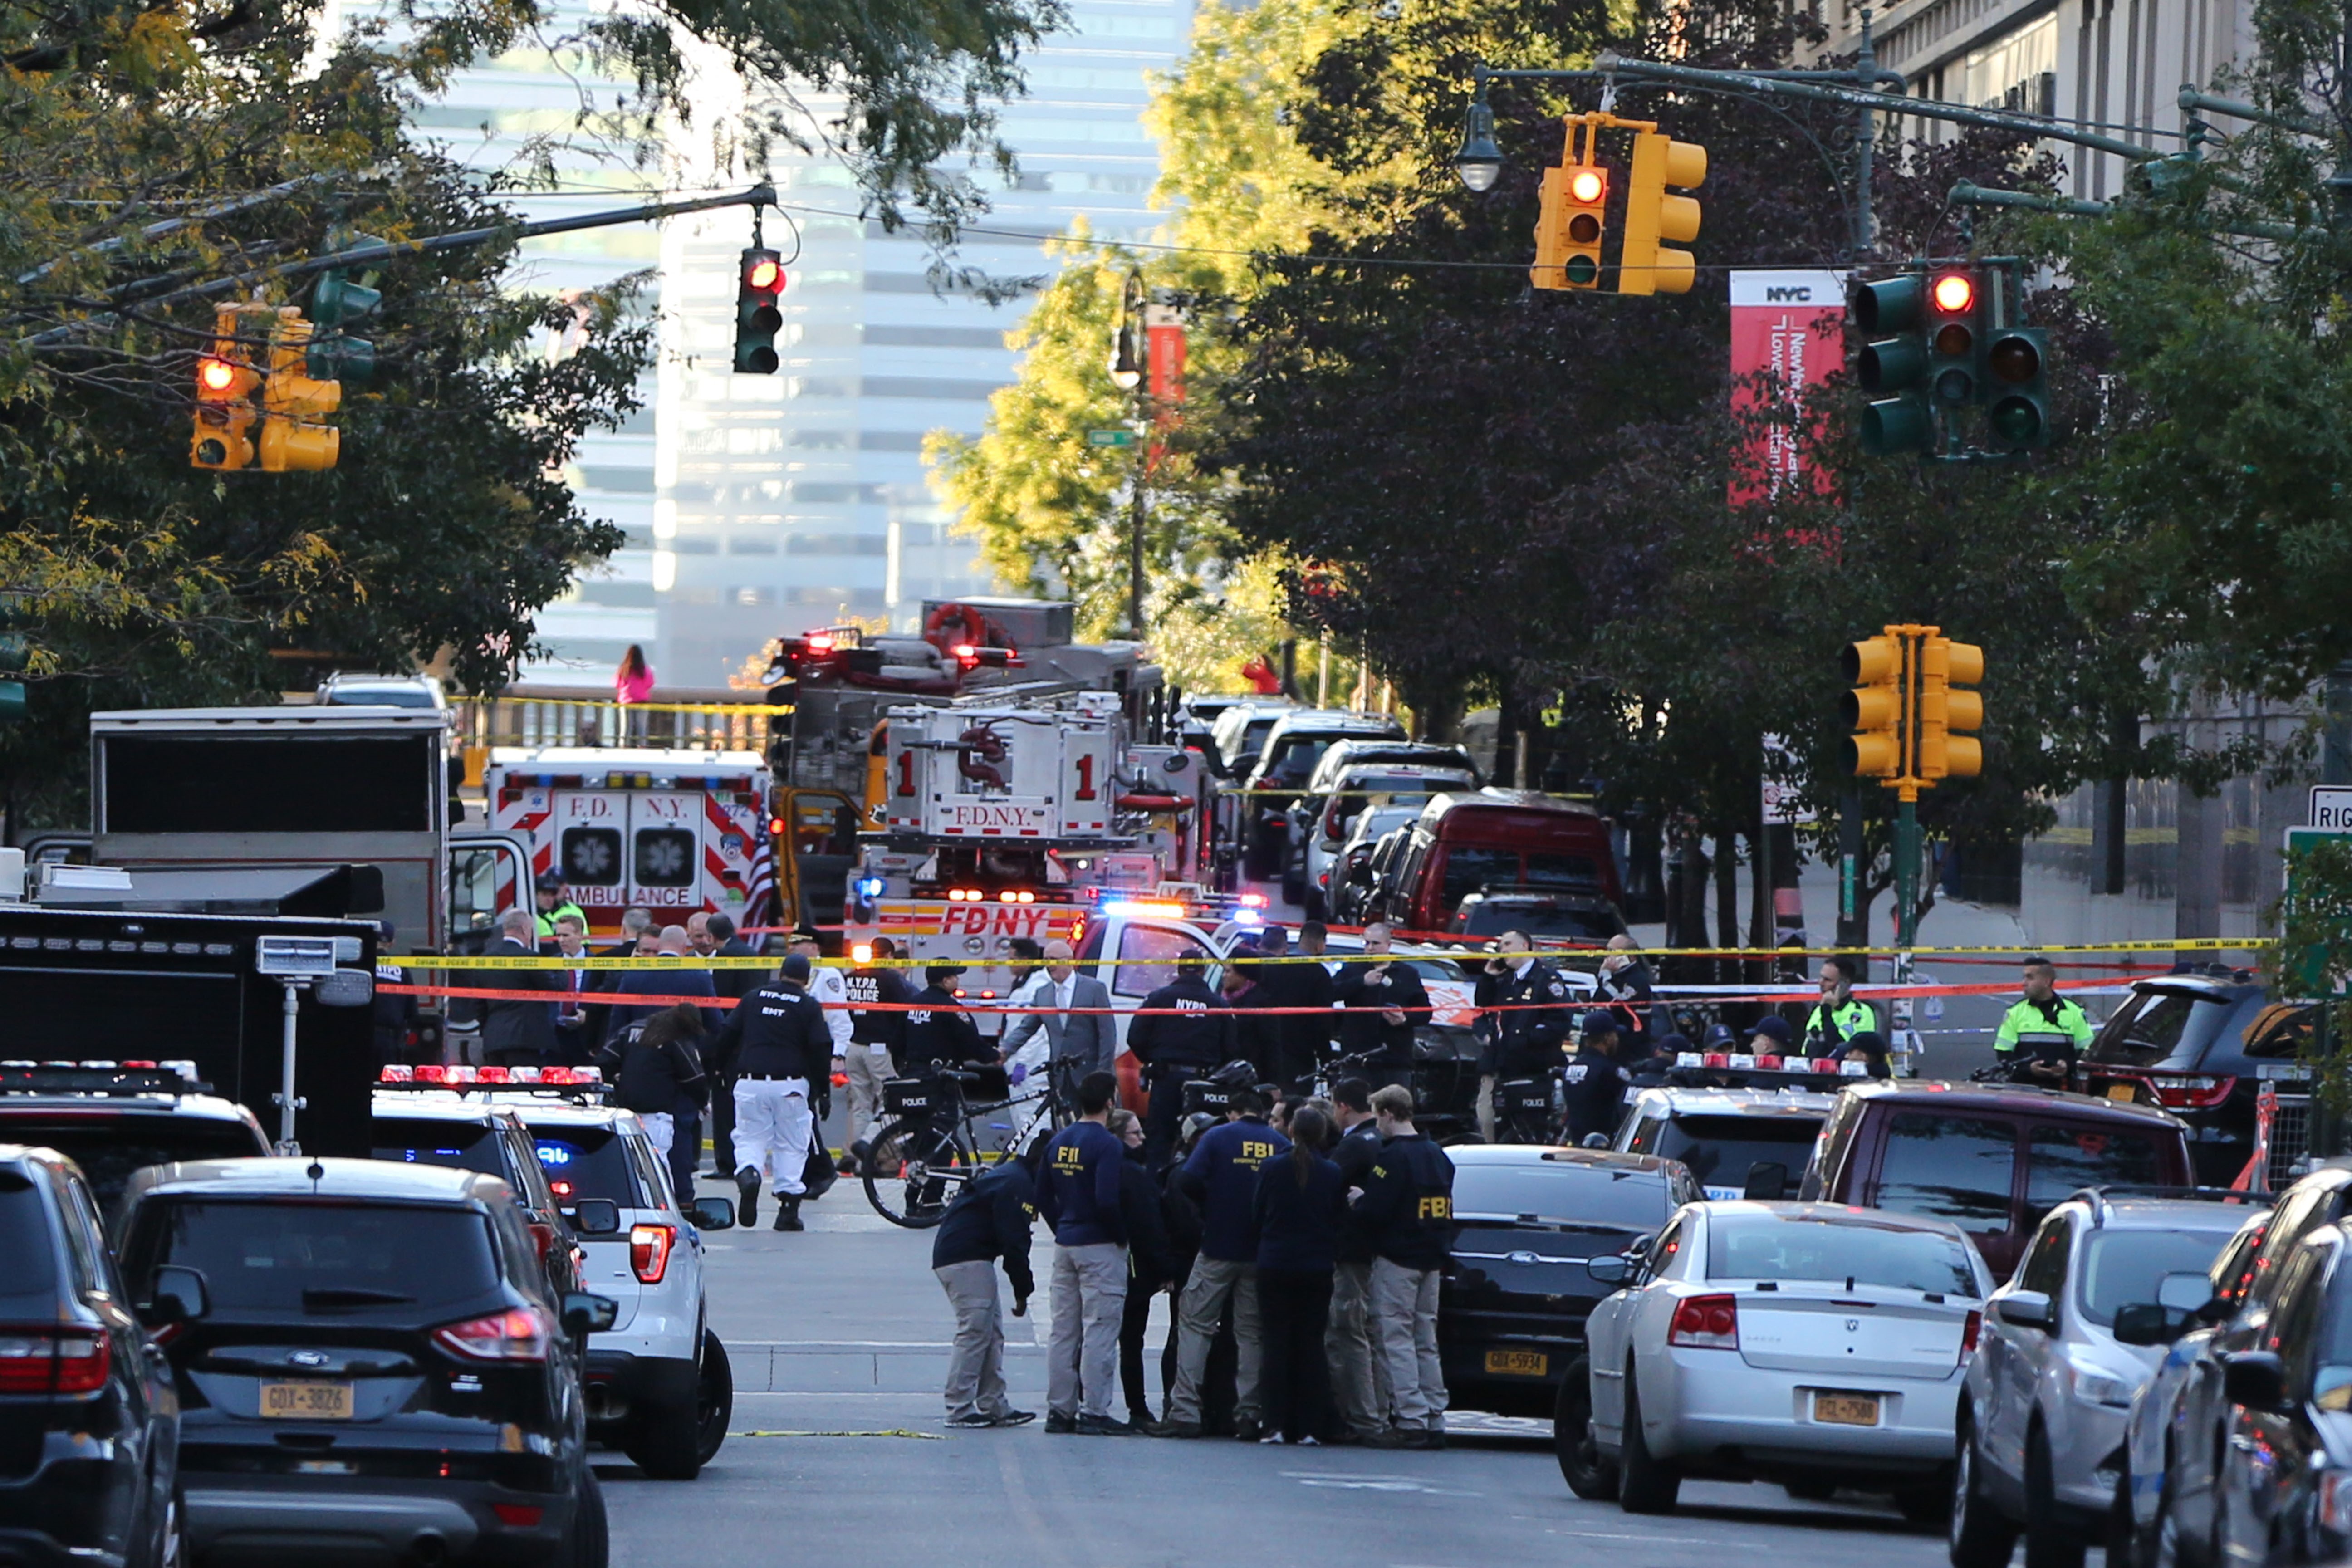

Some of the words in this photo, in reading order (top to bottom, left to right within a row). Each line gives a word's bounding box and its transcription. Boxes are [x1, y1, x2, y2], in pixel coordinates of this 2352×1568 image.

[1767, 287, 1811, 301] NYC
[897, 751, 915, 796] 1
[1076, 755, 1096, 800] 1
[570, 797, 612, 817] F.D.
[646, 799, 687, 818] N.Y.
[956, 806, 1031, 826] F.D.N.Y.
[2320, 807, 2352, 828] RIG
[564, 887, 690, 905] AMBULANCE
[942, 906, 1048, 936] FDNY
[846, 988, 880, 1002] POLICE
[1176, 998, 1208, 1010] NYPD
[762, 1006, 785, 1017] EMT
[902, 1097, 927, 1106] POLICE
[1204, 1093, 1229, 1103] POLICE
[1523, 1098, 1545, 1107] POLICE
[1007, 1114, 1037, 1152] NYPD
[1242, 1141, 1274, 1158] FBI
[1418, 1196, 1451, 1220] FBI
